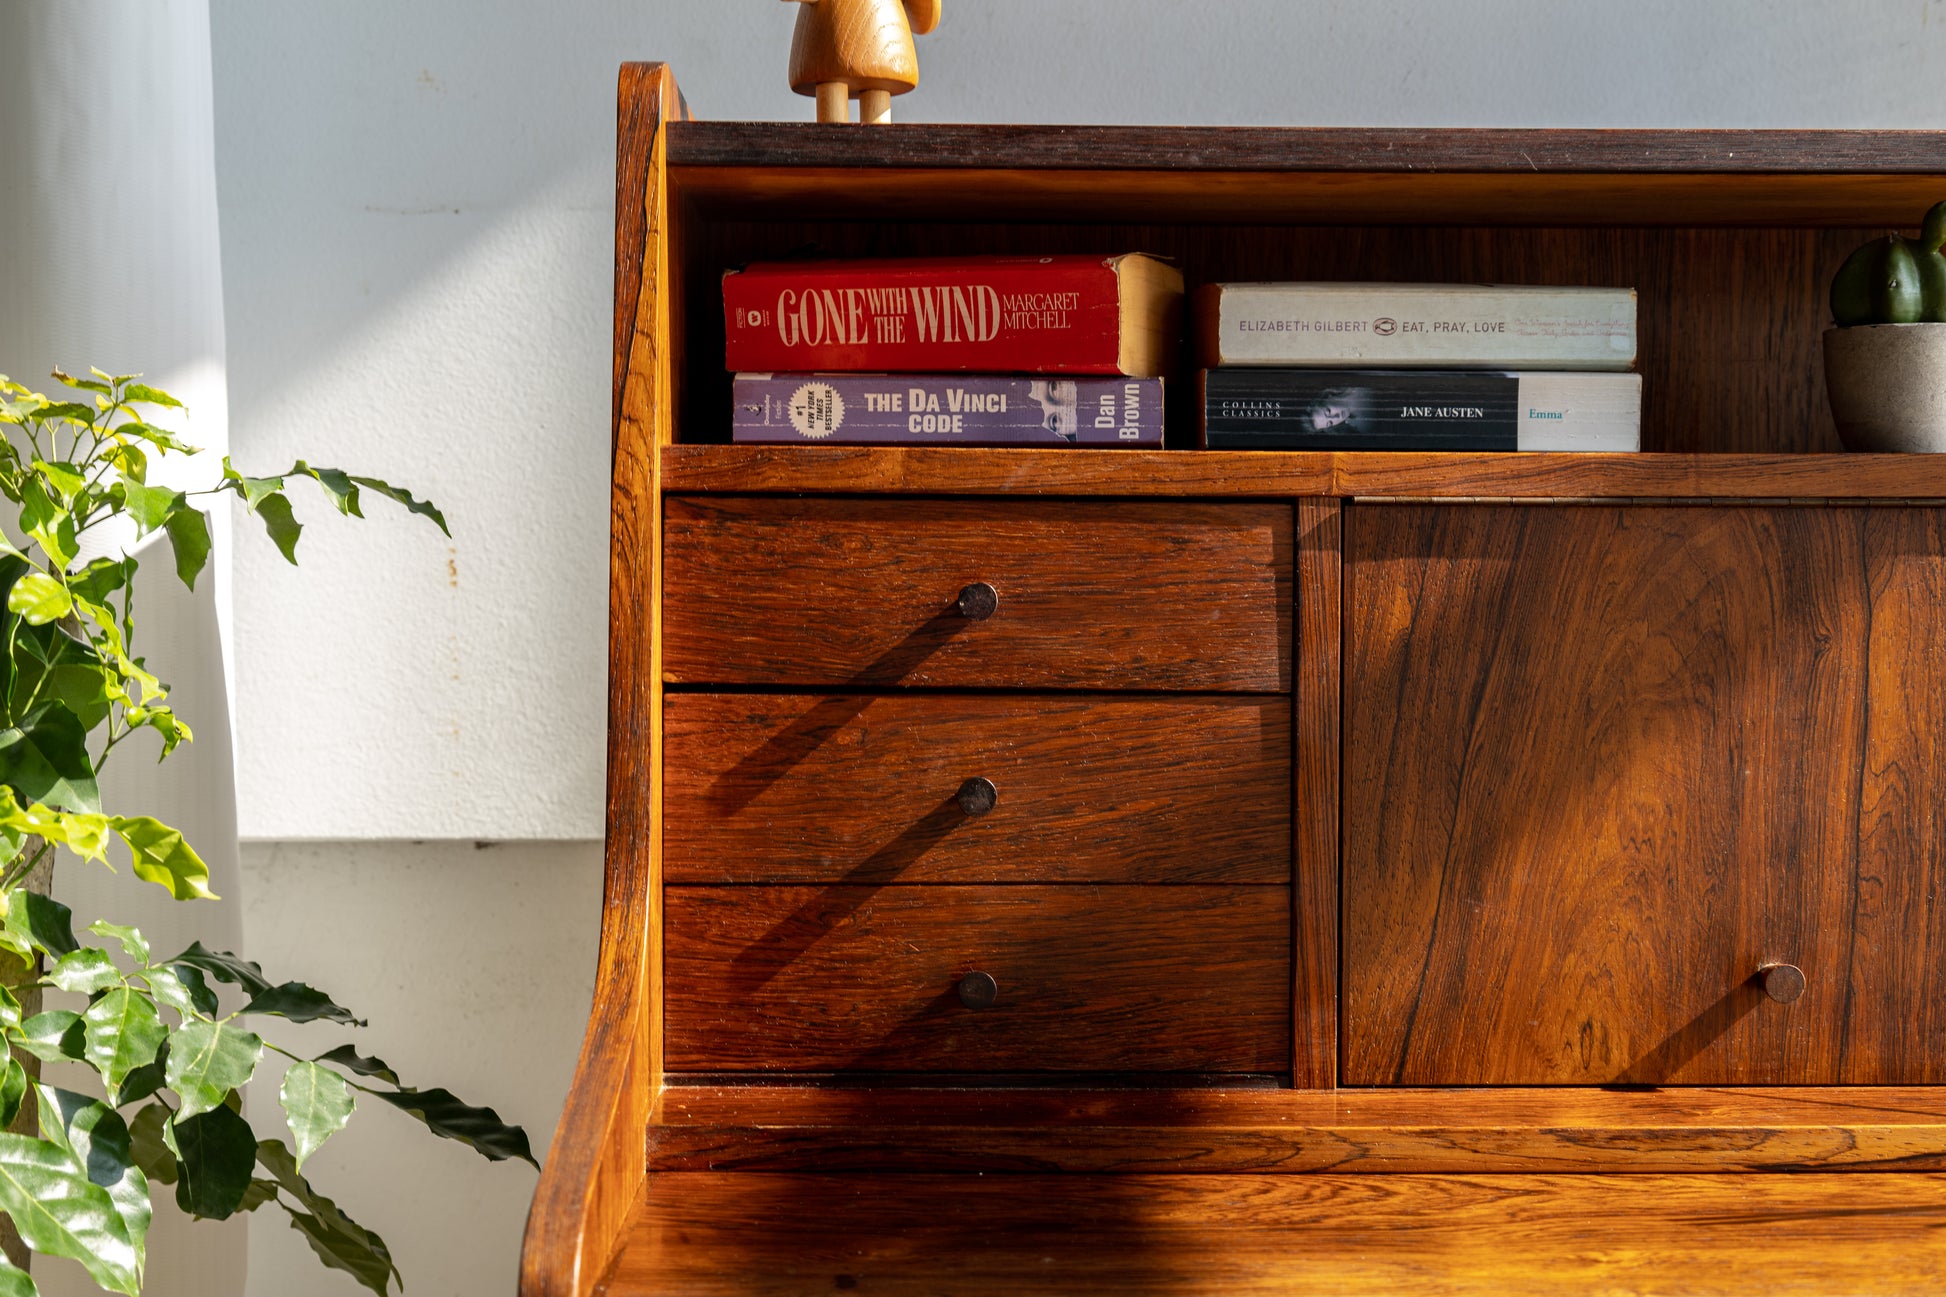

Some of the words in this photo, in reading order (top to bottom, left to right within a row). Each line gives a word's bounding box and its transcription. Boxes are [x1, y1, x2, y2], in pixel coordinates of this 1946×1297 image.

[866, 287, 908, 315] WITH
[1003, 292, 1079, 311] MARGARET
[777, 288, 868, 347] GONE
[909, 285, 1000, 343] WIND
[1004, 310, 1071, 330] MITCHELL
[873, 316, 905, 343] THE
[1239, 320, 1310, 332] ELIZABETH
[1314, 321, 1368, 332] GILBERT
[1402, 322, 1429, 334] EAT,
[1434, 322, 1470, 334] PRAY,
[1474, 322, 1505, 333] LOVE
[807, 390, 815, 410] YORK
[864, 393, 902, 412] THE
[1222, 401, 1281, 410] COLLINS
[807, 412, 815, 429] NEW
[1095, 395, 1115, 428] Dan
[1119, 384, 1140, 439] Brown
[1222, 409, 1281, 417] CLASSICS
[1401, 406, 1432, 418] JANE
[1434, 407, 1484, 418] AUSTEN
[1529, 408, 1563, 420] Emma
[908, 414, 963, 433] CODE
